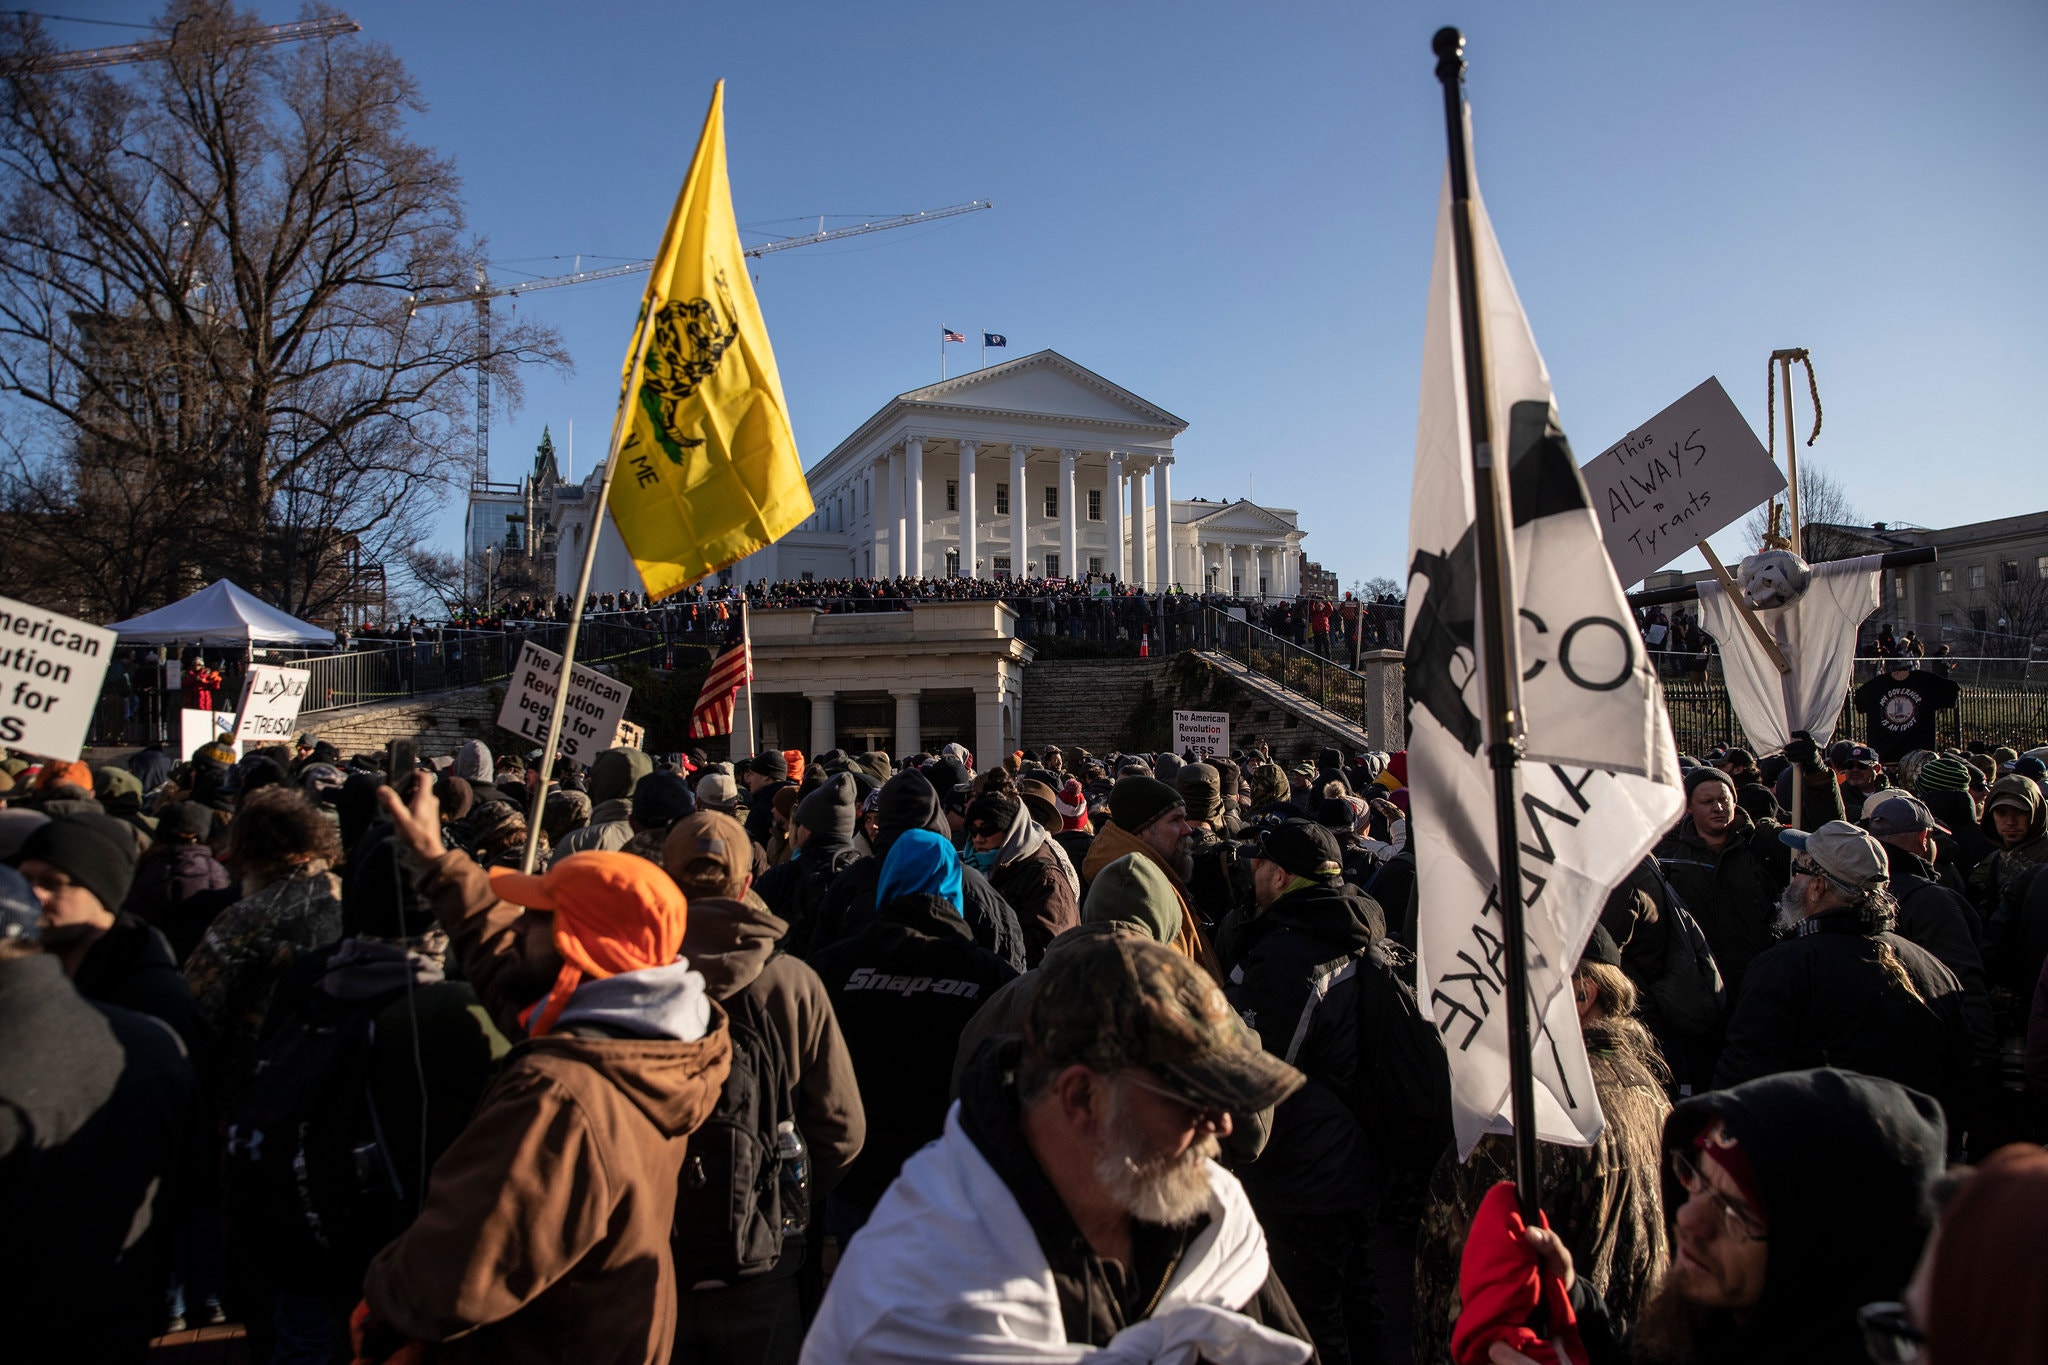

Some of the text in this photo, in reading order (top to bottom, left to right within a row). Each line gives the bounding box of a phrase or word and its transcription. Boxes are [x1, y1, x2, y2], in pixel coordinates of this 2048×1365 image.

[629, 455, 660, 489] ME
[1607, 428, 1706, 523] ALWAYS
[1627, 491, 1711, 555] Tyrants
[524, 646, 551, 671] The
[12, 682, 59, 713] for
[524, 671, 605, 721] Revoution
[1880, 687, 1922, 706] MY GOVERNOR
[253, 715, 294, 737] TREASON
[519, 693, 597, 739] begn for
[1174, 712, 1226, 723] The American
[1179, 723, 1221, 734] Revolution
[1888, 723, 1899, 731] AN
[1900, 717, 1917, 732] IDIOT
[1180, 734, 1220, 744] began for
[843, 967, 980, 998] Snap-on
